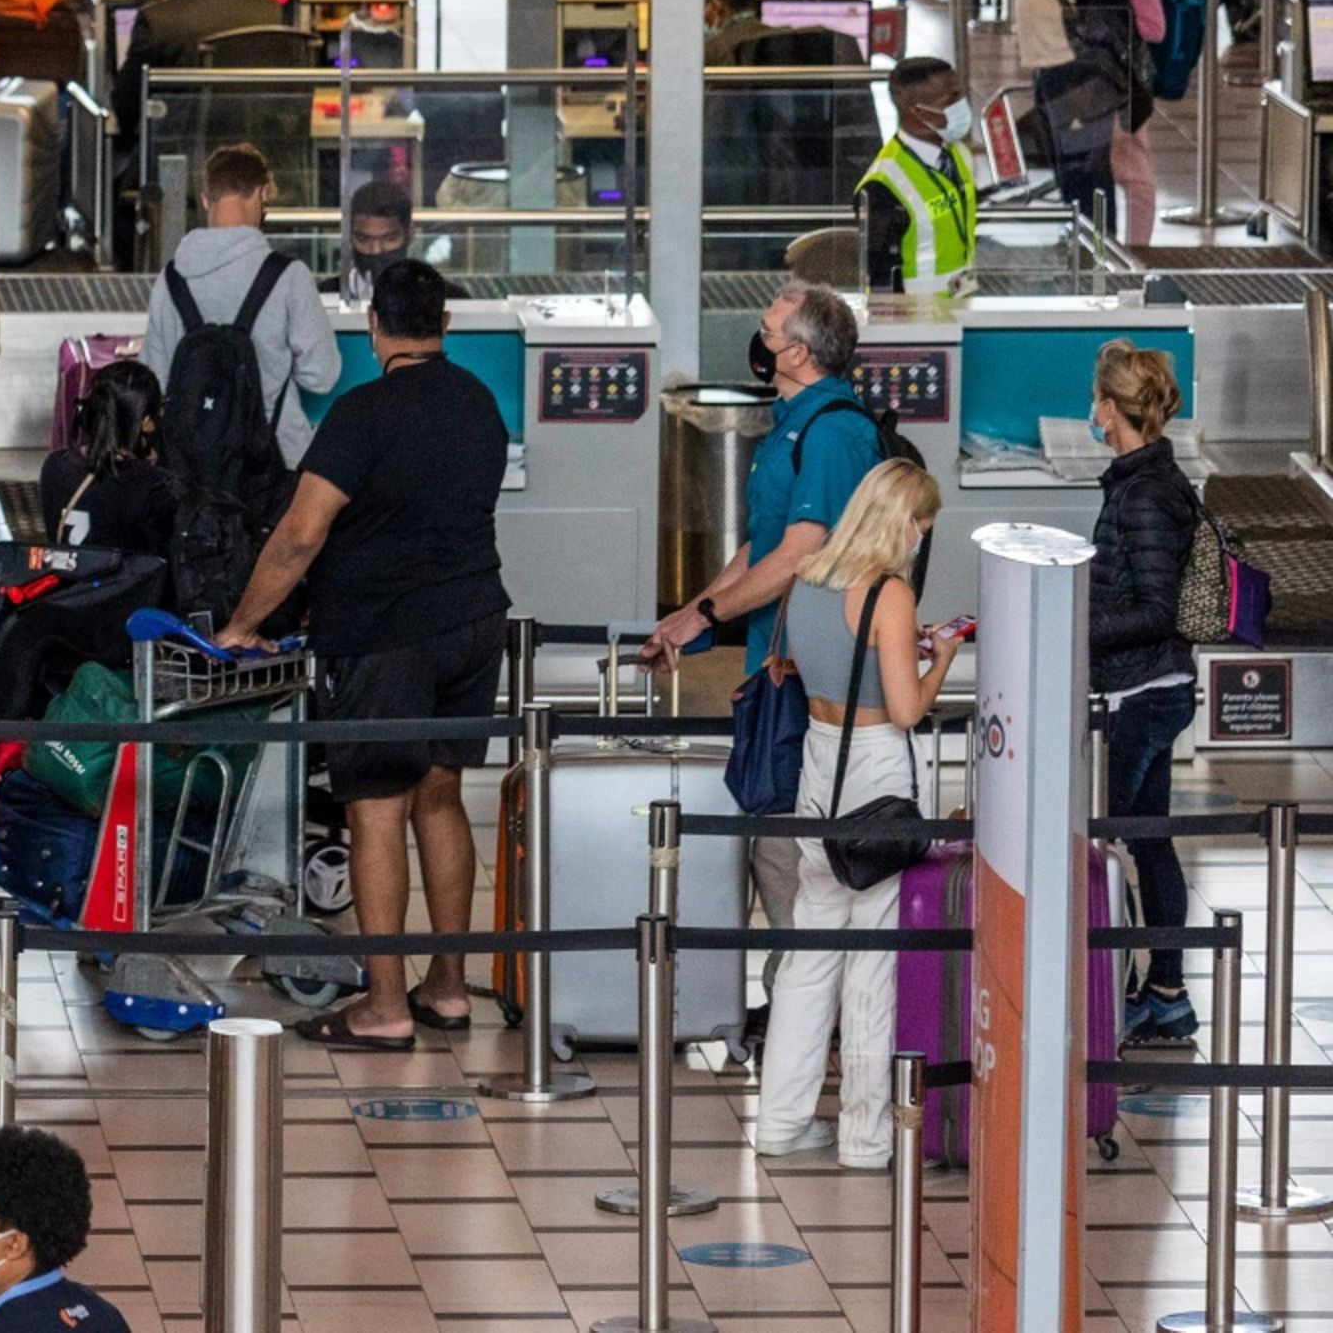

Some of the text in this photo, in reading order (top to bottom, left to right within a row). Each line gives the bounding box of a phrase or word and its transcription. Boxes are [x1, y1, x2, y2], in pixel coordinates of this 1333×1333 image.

[1253, 694, 1280, 703] please
[1222, 703, 1280, 713] guard children
[1250, 713, 1281, 722] rotating
